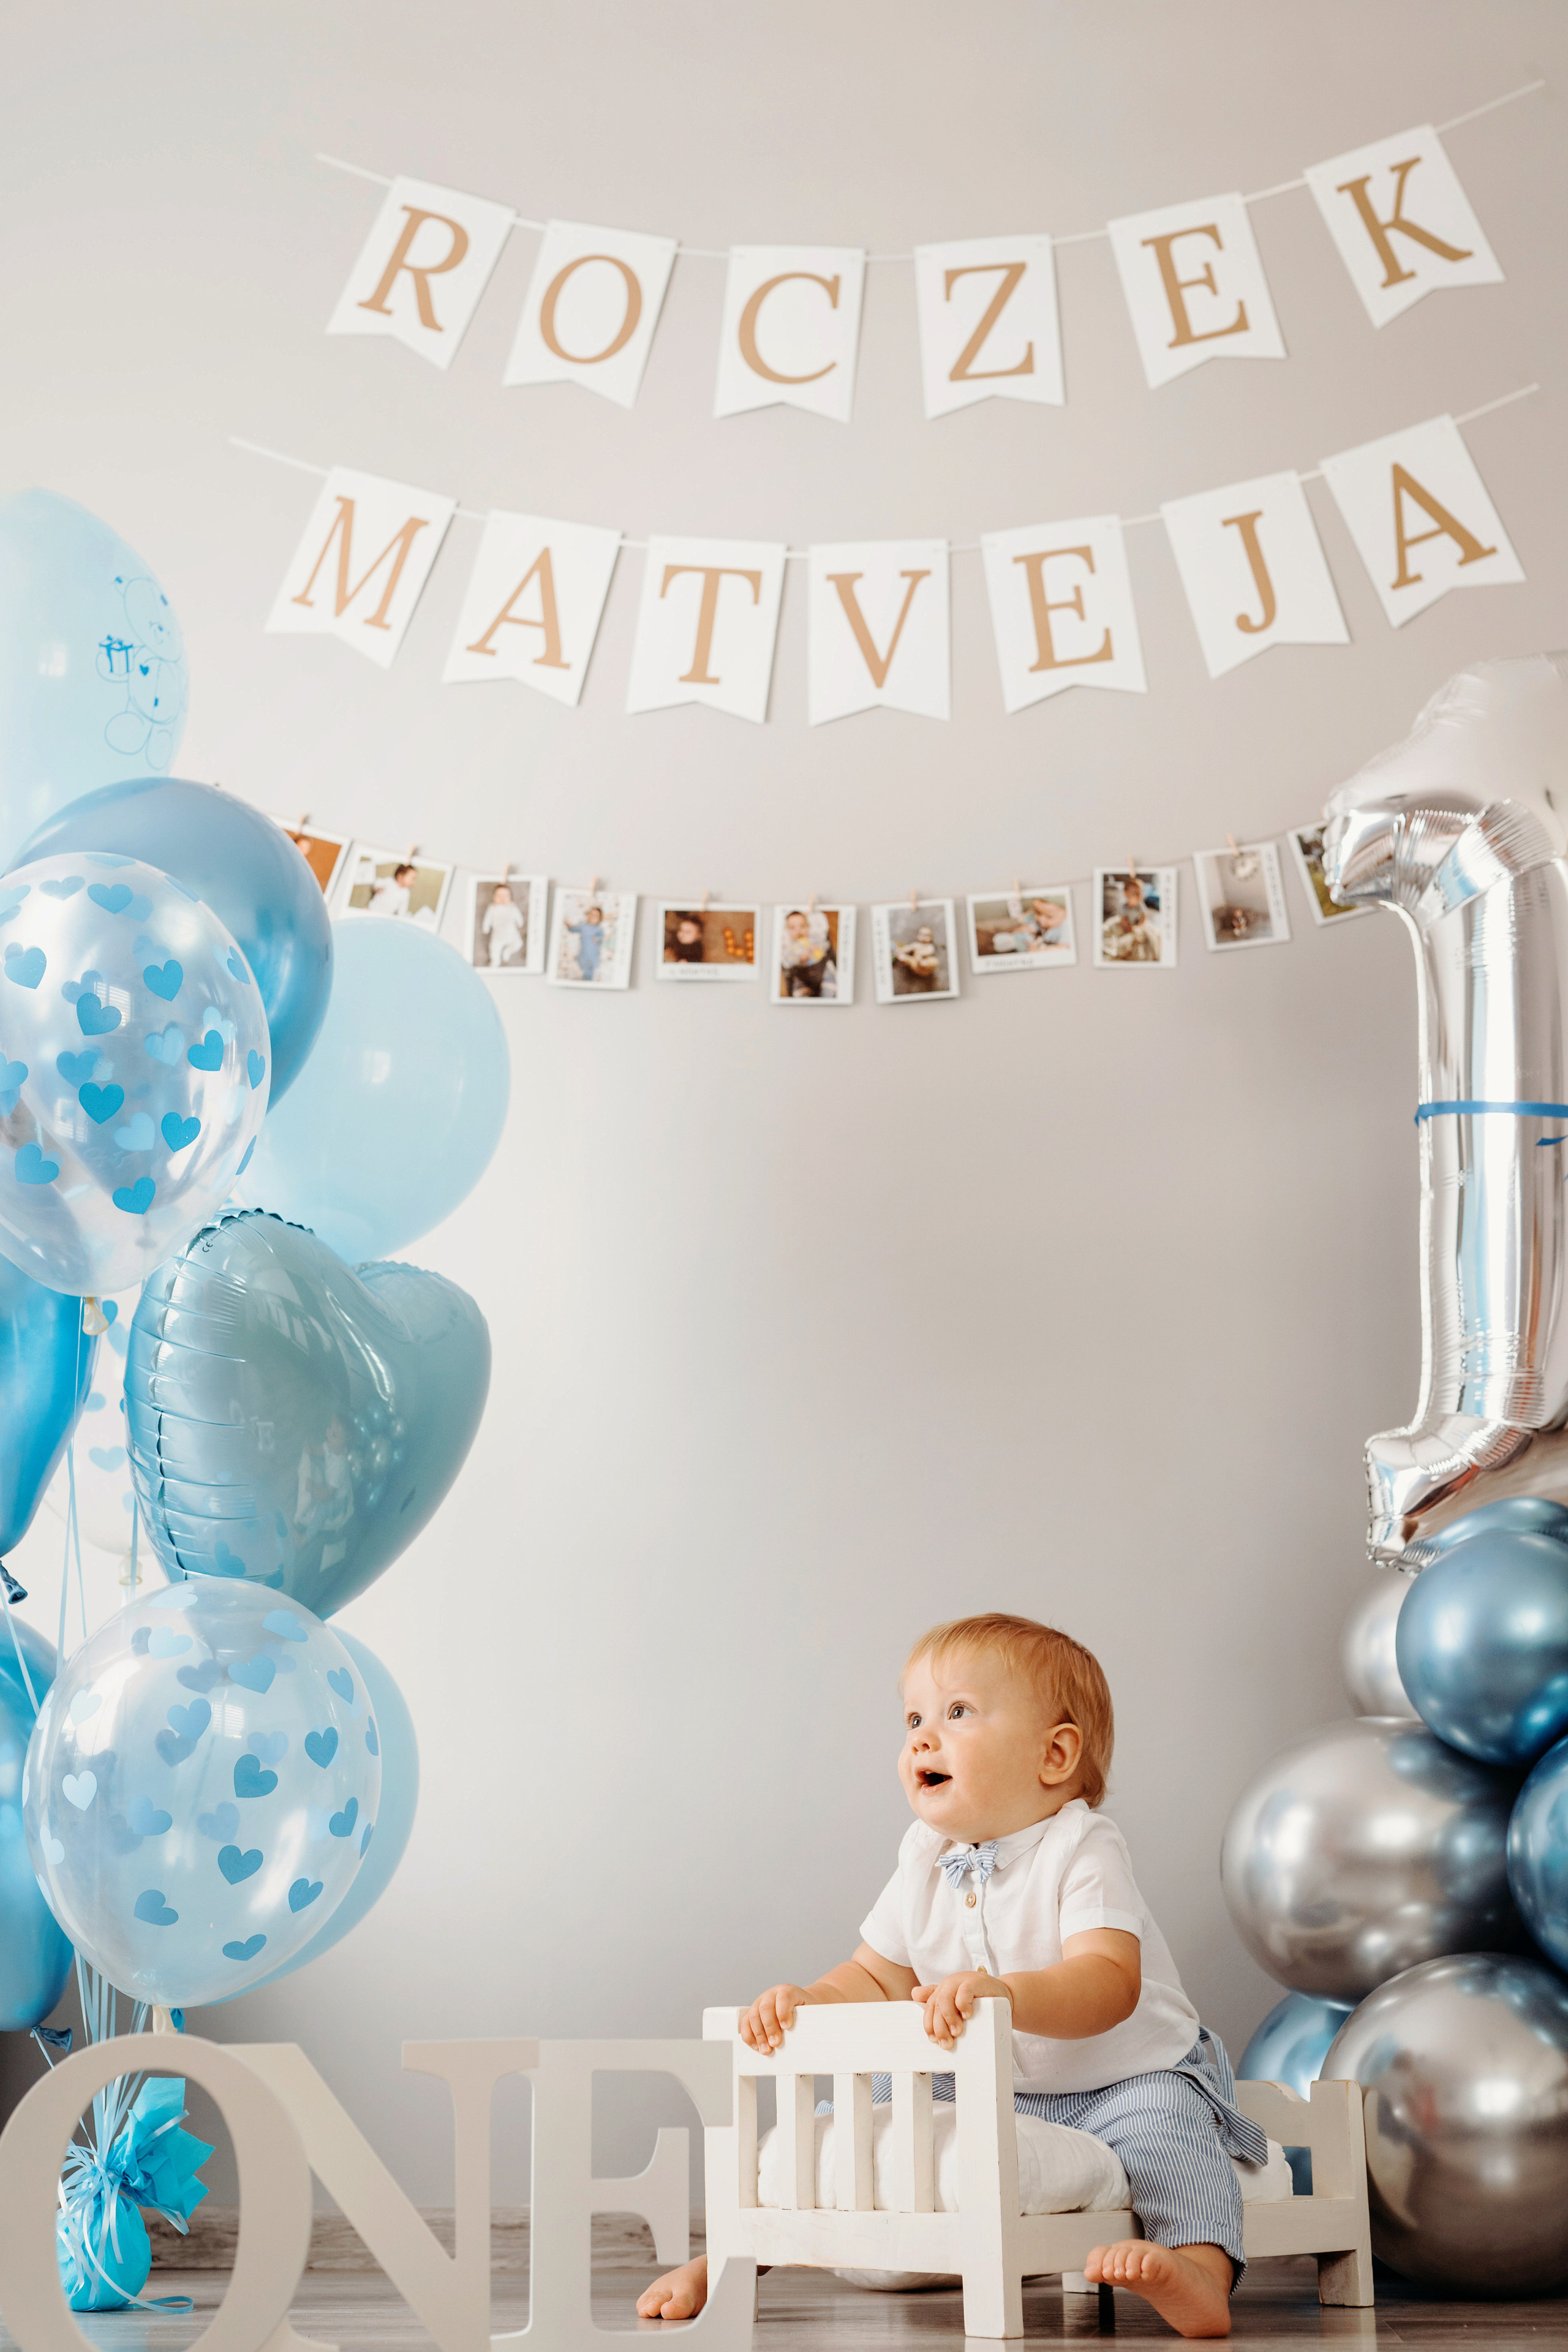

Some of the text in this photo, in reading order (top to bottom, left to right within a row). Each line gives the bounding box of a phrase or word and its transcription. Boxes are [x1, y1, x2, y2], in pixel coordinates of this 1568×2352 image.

[359, 157, 1472, 383] ROCZEK
[293, 464, 1496, 687] MATVEJA
[0, 2034, 757, 2352] ONE
